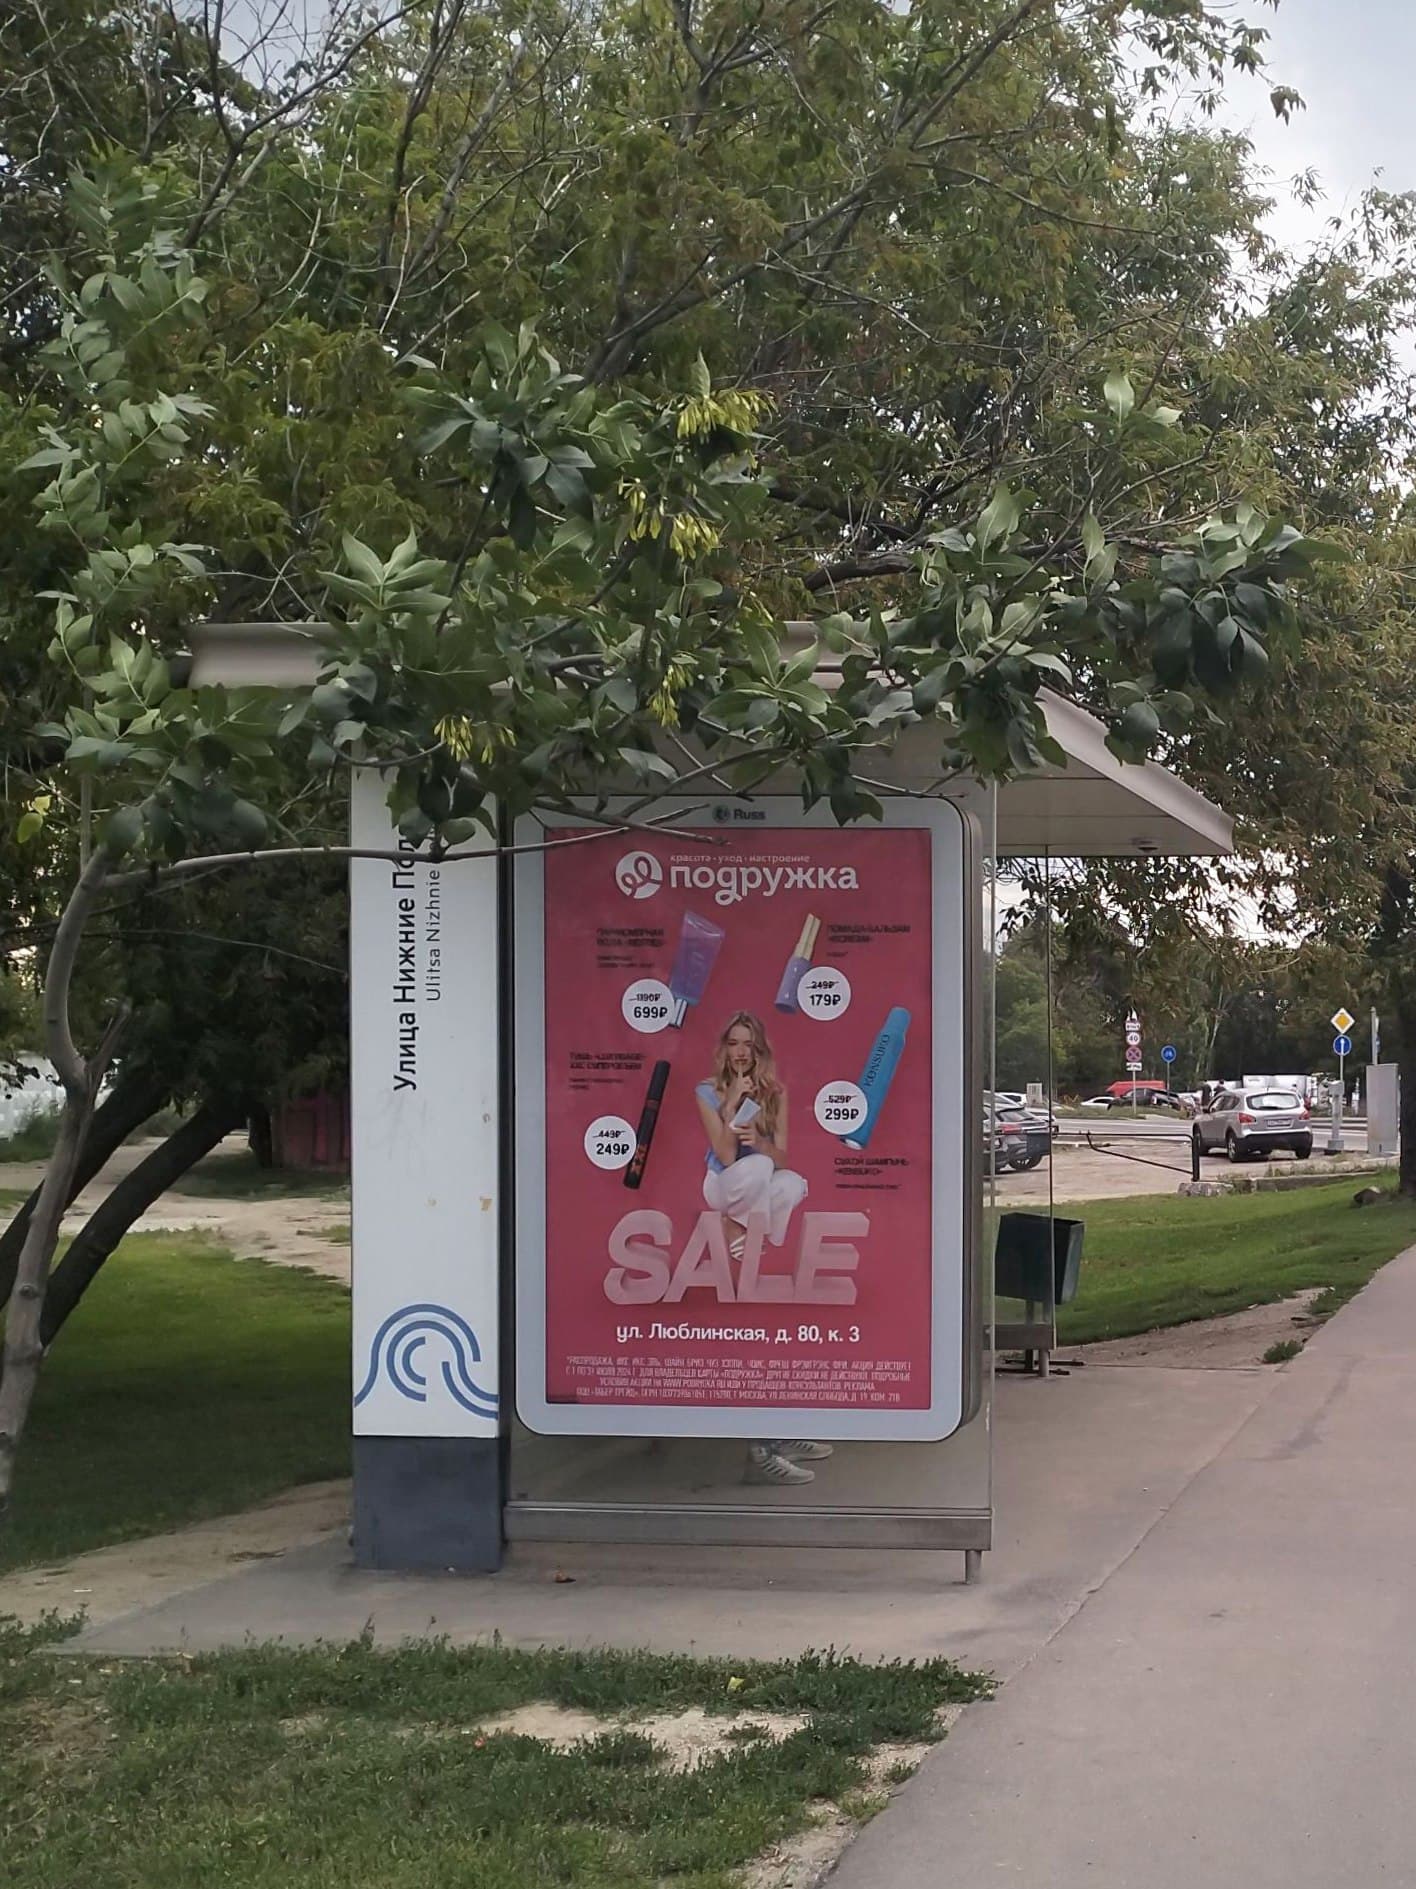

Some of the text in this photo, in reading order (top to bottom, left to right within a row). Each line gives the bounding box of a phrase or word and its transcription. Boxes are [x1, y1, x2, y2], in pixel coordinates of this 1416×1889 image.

[733, 808, 766, 820] Russ
[749, 854, 811, 864] настроение
[670, 866, 859, 905] подружка
[425, 869, 441, 1001] Ulitsa Nizhnie
[392, 824, 419, 1091] Улица Нижние Пол
[809, 994, 842, 1006] 179₽
[633, 1006, 668, 1019] 699₽
[825, 1108, 860, 1121] 299₽
[596, 1143, 630, 1155] 249₽
[616, 1323, 860, 1344] ул. Люблинская, д. 80, к. 3
